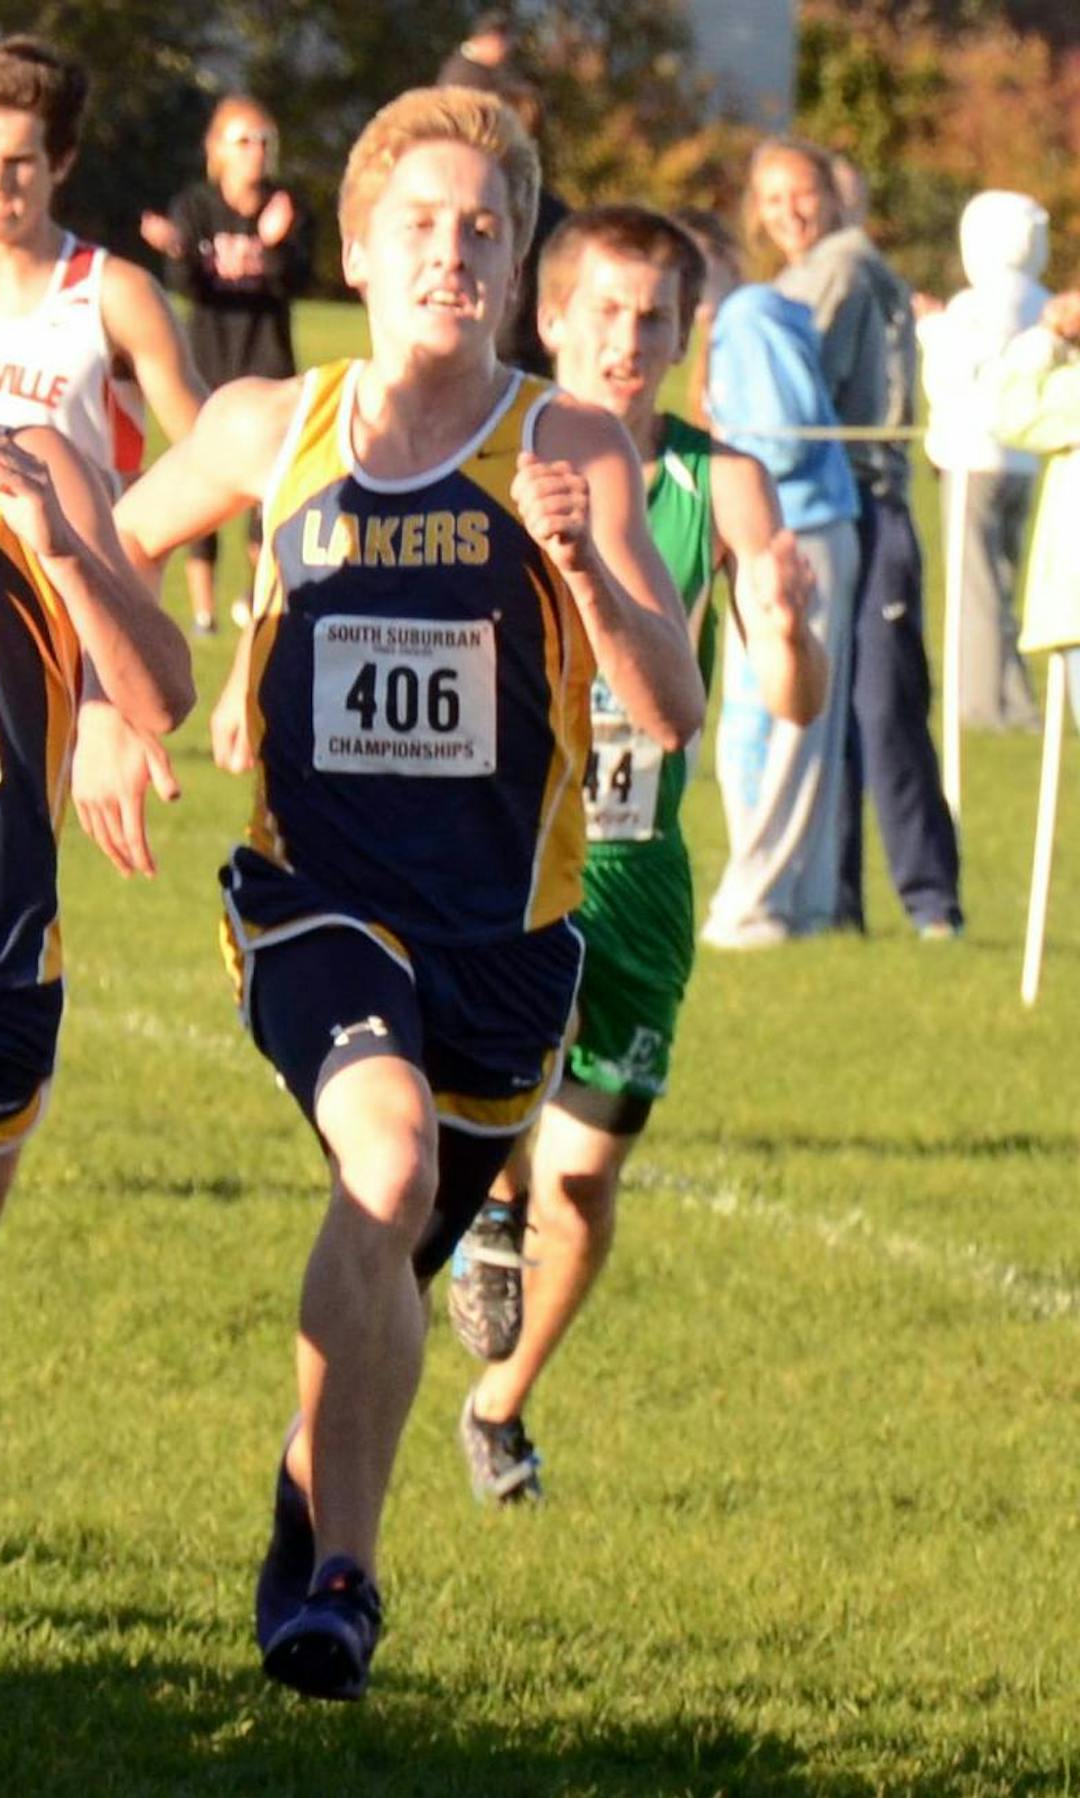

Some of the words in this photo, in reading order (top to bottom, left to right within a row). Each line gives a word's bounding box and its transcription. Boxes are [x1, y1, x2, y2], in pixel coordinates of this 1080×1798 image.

[302, 509, 489, 567] LAKERS
[327, 624, 381, 644] SOUTH
[387, 629, 481, 649] SUBURBAN
[346, 662, 460, 733] 406
[328, 737, 474, 760] CHAMPIONSHIPS
